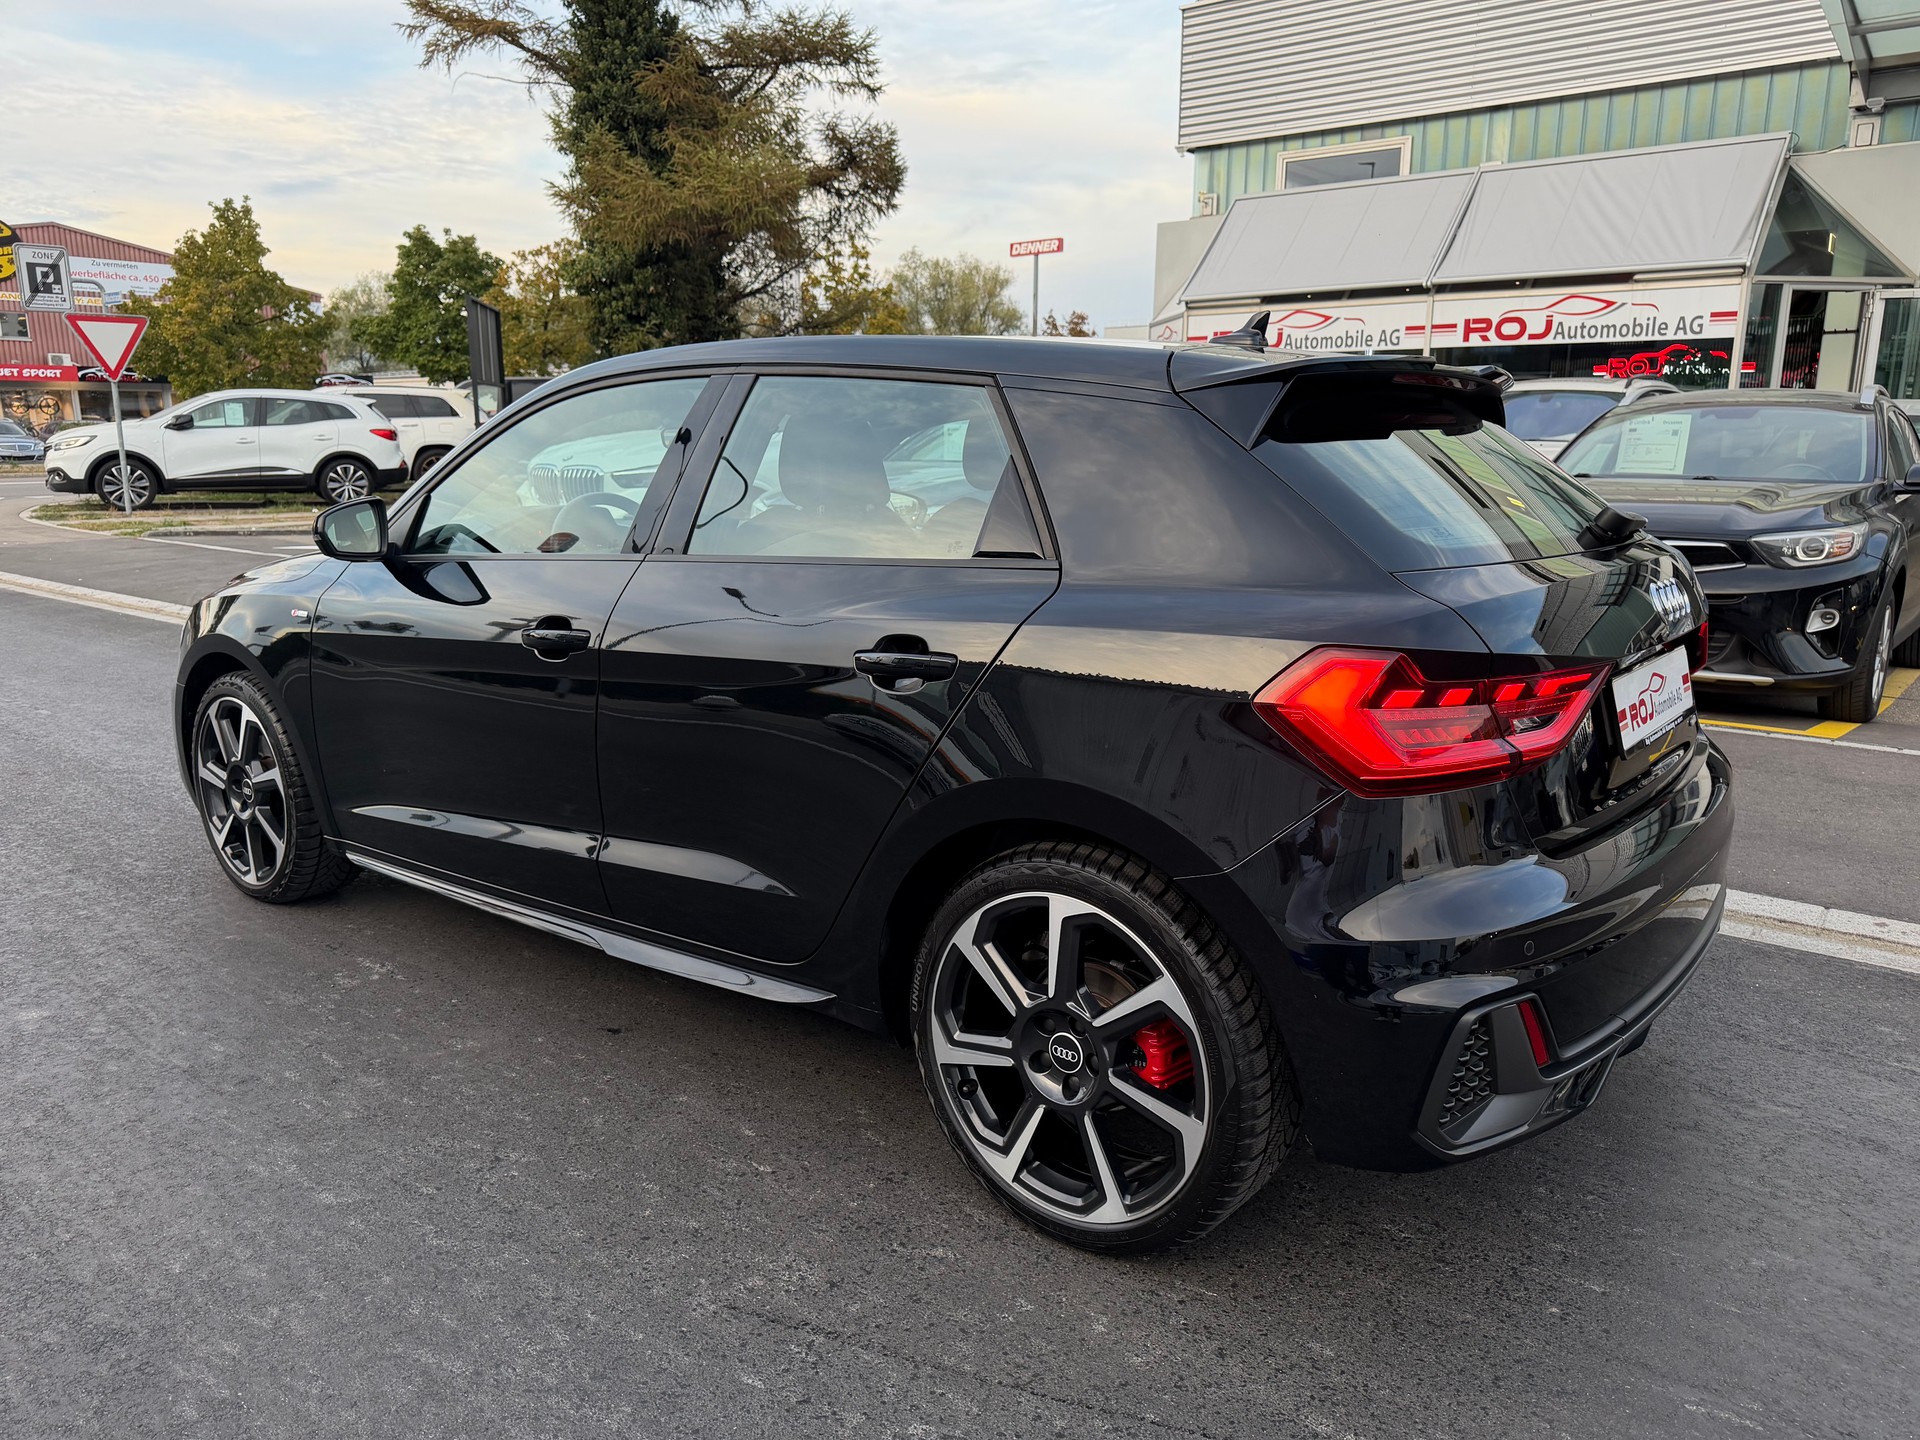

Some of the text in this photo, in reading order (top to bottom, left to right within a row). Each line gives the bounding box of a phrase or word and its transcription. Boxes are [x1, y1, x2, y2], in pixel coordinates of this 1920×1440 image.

[31, 250, 55, 261] ZONE
[1011, 239, 1059, 256] DENNER
[91, 259, 139, 270] Zu vermieten
[128, 274, 141, 283] ca.
[143, 275, 160, 284] 450
[1462, 314, 1704, 343] ROJ Automobile AG
[1284, 330, 1373, 350] Automobile
[1377, 328, 1401, 347] AG
[22, 368, 63, 378] SPORT
[1629, 693, 1655, 732] ROJ
[911, 940, 932, 1013] UNIROYAL
